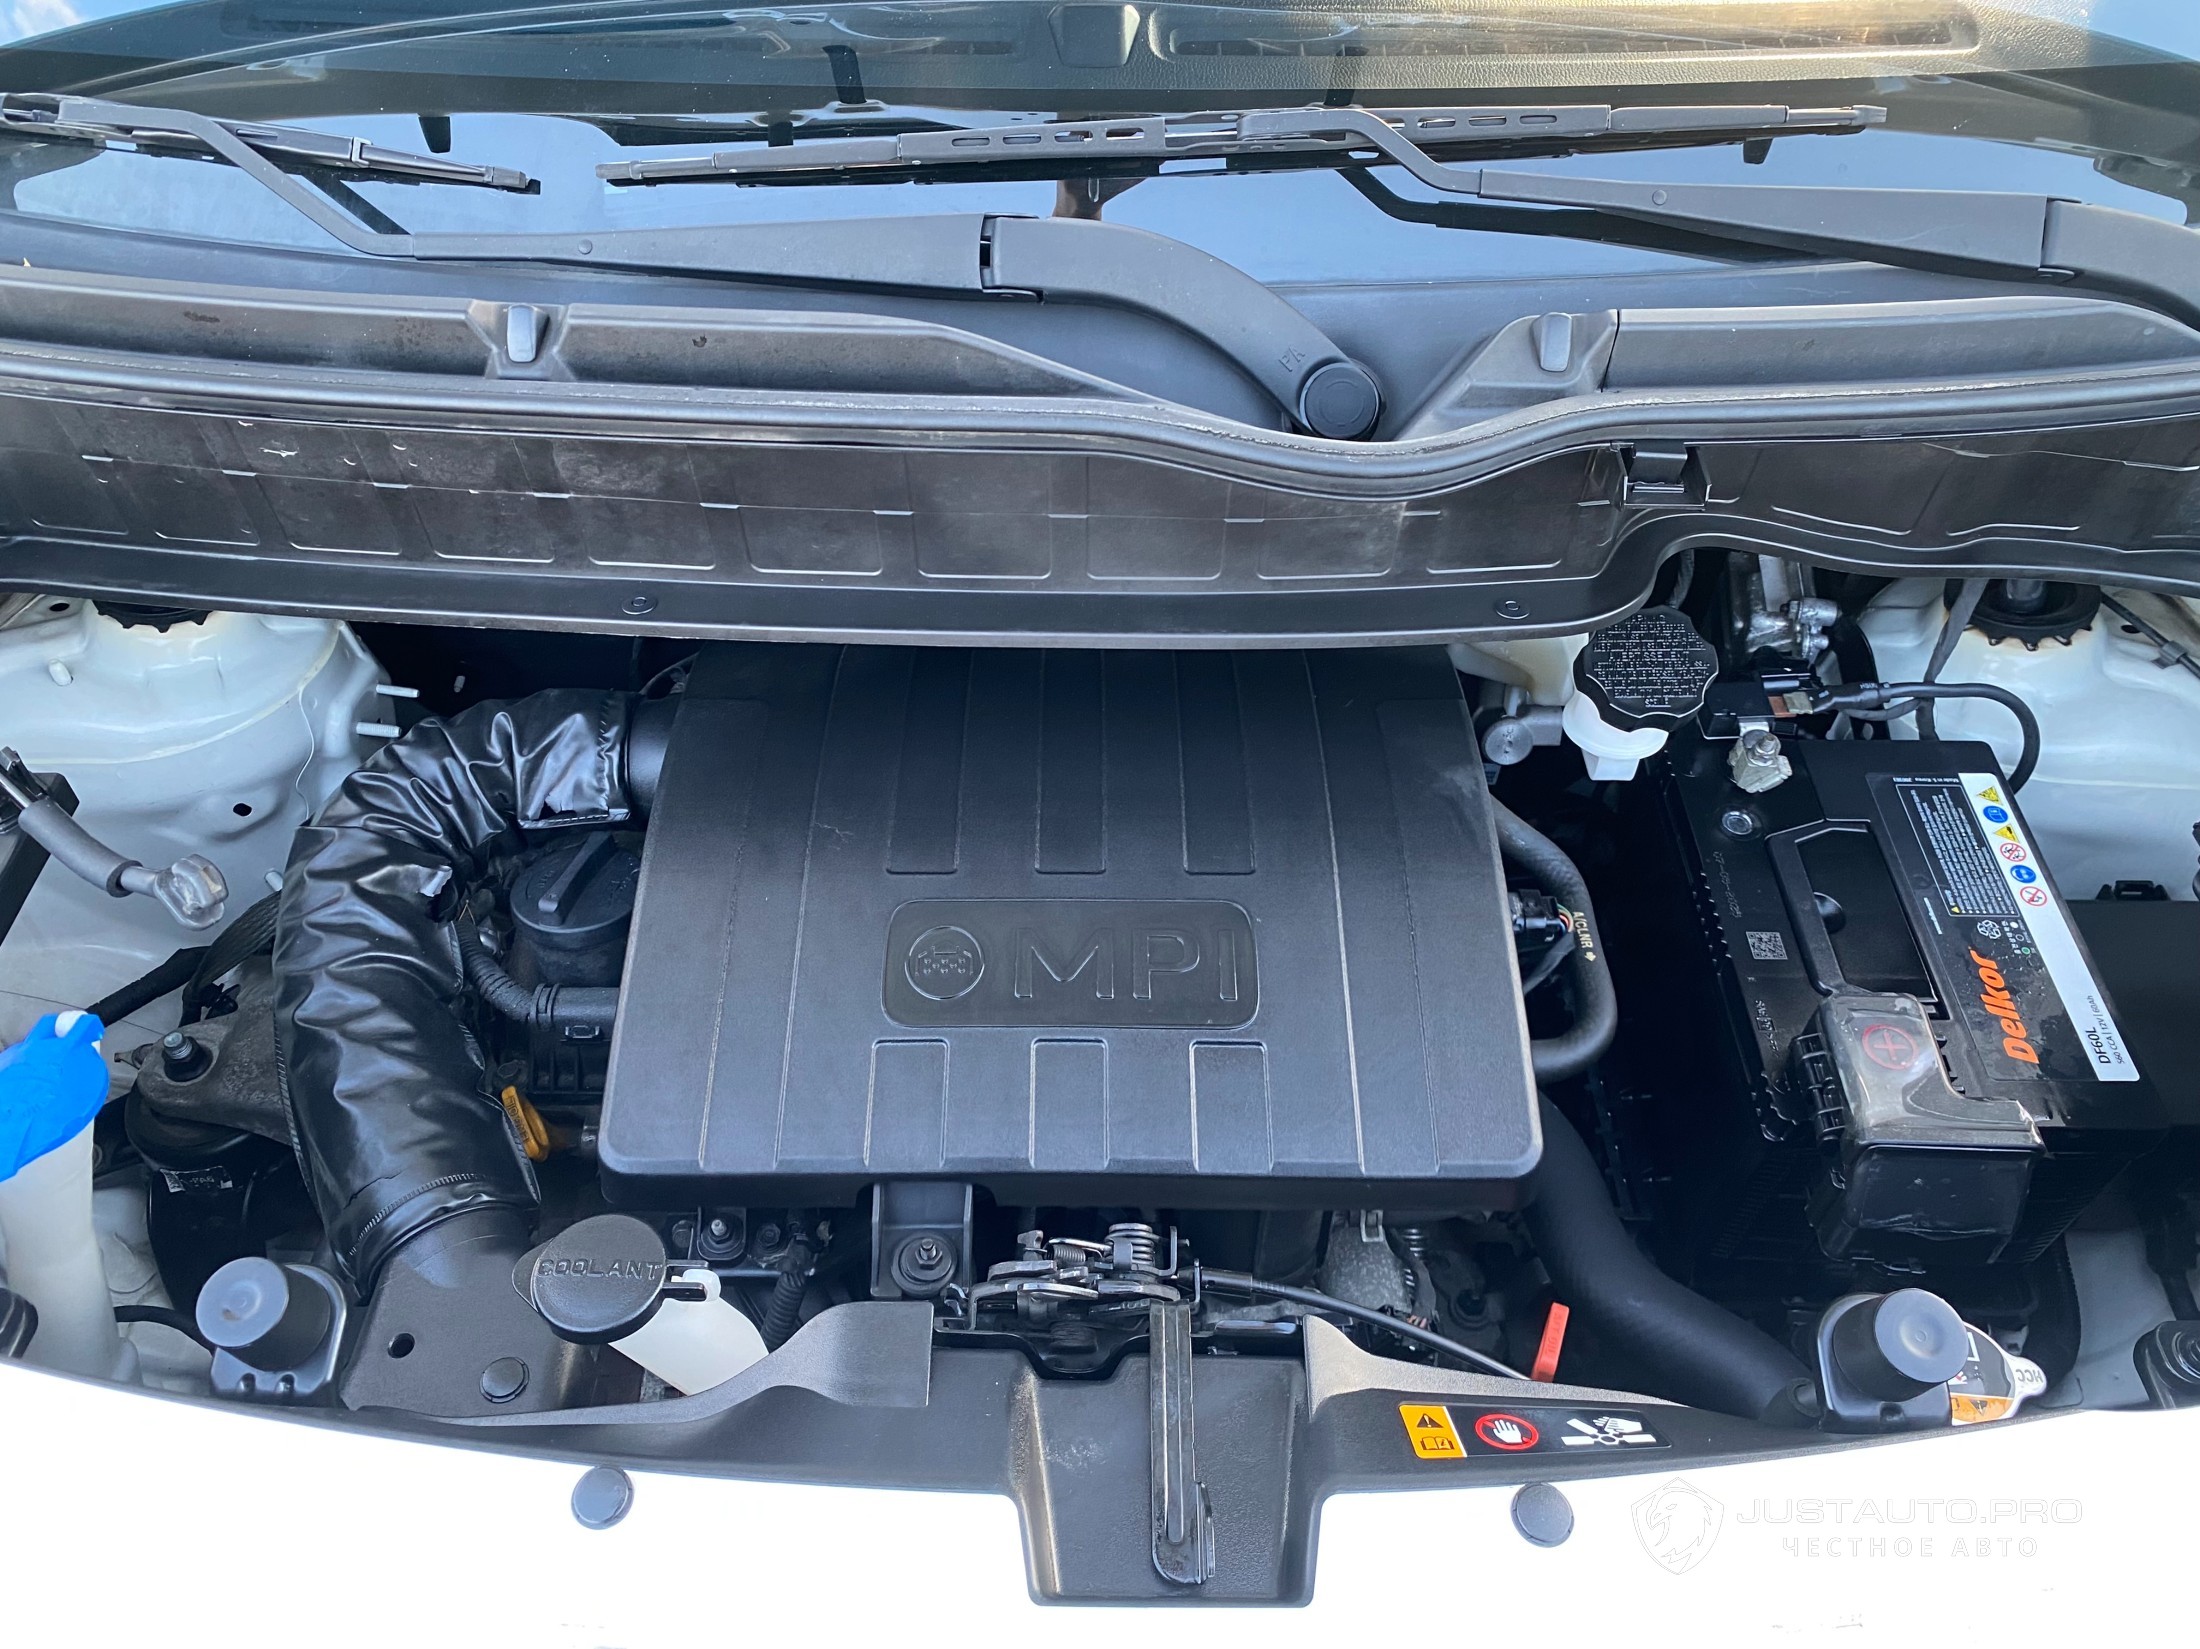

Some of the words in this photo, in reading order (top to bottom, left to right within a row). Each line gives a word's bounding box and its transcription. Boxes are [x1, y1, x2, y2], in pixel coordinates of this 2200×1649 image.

[1014, 926, 1239, 1001] MPI
[1969, 949, 2040, 1064] Delkor
[2096, 1017, 2109, 1030] 12V
[2085, 1026, 2112, 1064] DF60L
[2106, 1035, 2118, 1050] CCA
[2113, 1051, 2126, 1065] 560
[537, 1257, 664, 1281] COOLANT
